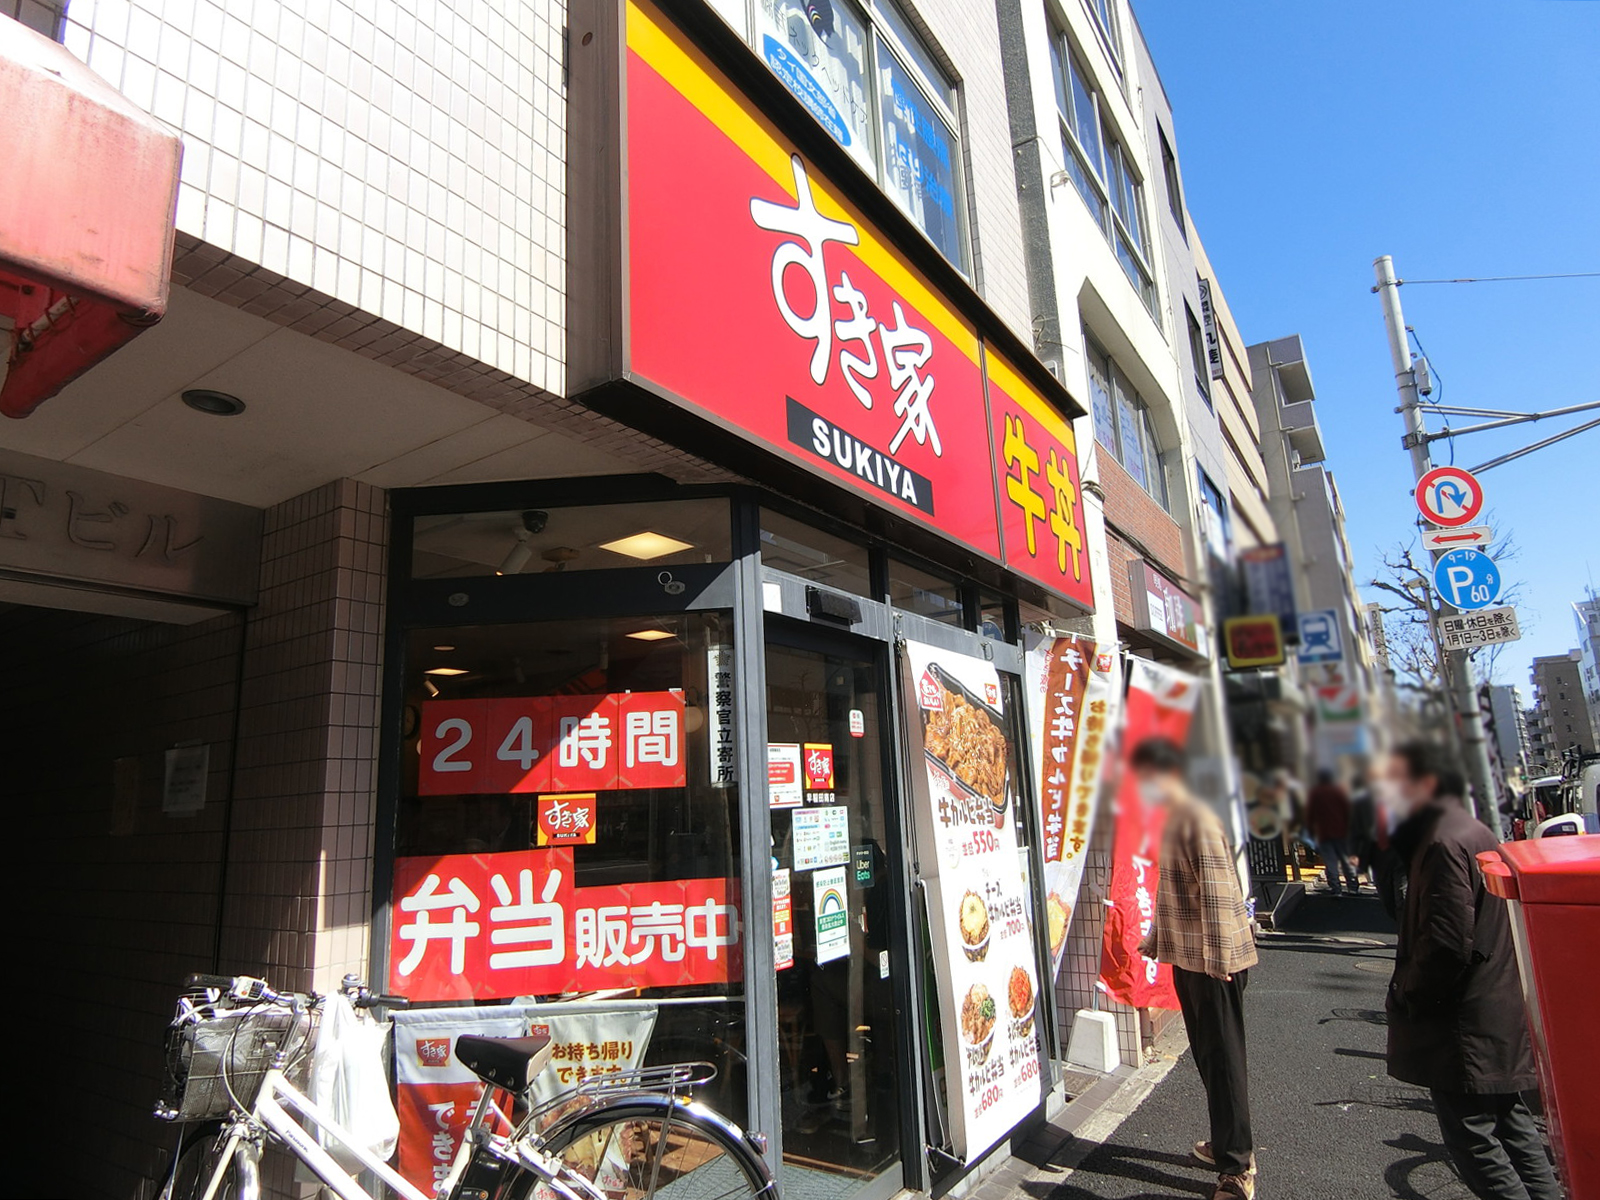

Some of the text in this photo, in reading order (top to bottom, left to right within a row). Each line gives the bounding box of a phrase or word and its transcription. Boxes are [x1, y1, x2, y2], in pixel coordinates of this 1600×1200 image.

[750, 153, 943, 458] すき家
[811, 417, 919, 506] SUKIYA
[1004, 412, 1082, 582] 牛丼
[1447, 566, 1474, 605] P
[432, 710, 679, 773] 24時間
[714, 671, 734, 782] 警察官立寄所
[807, 749, 830, 778] すき家
[544, 800, 589, 832] すき家
[938, 796, 994, 828] 牛カルビ弁当
[856, 859, 870, 869] Uber
[857, 870, 870, 880] Eats
[420, 1041, 447, 1059] すき家
[551, 1040, 633, 1062] お持ち帰り
